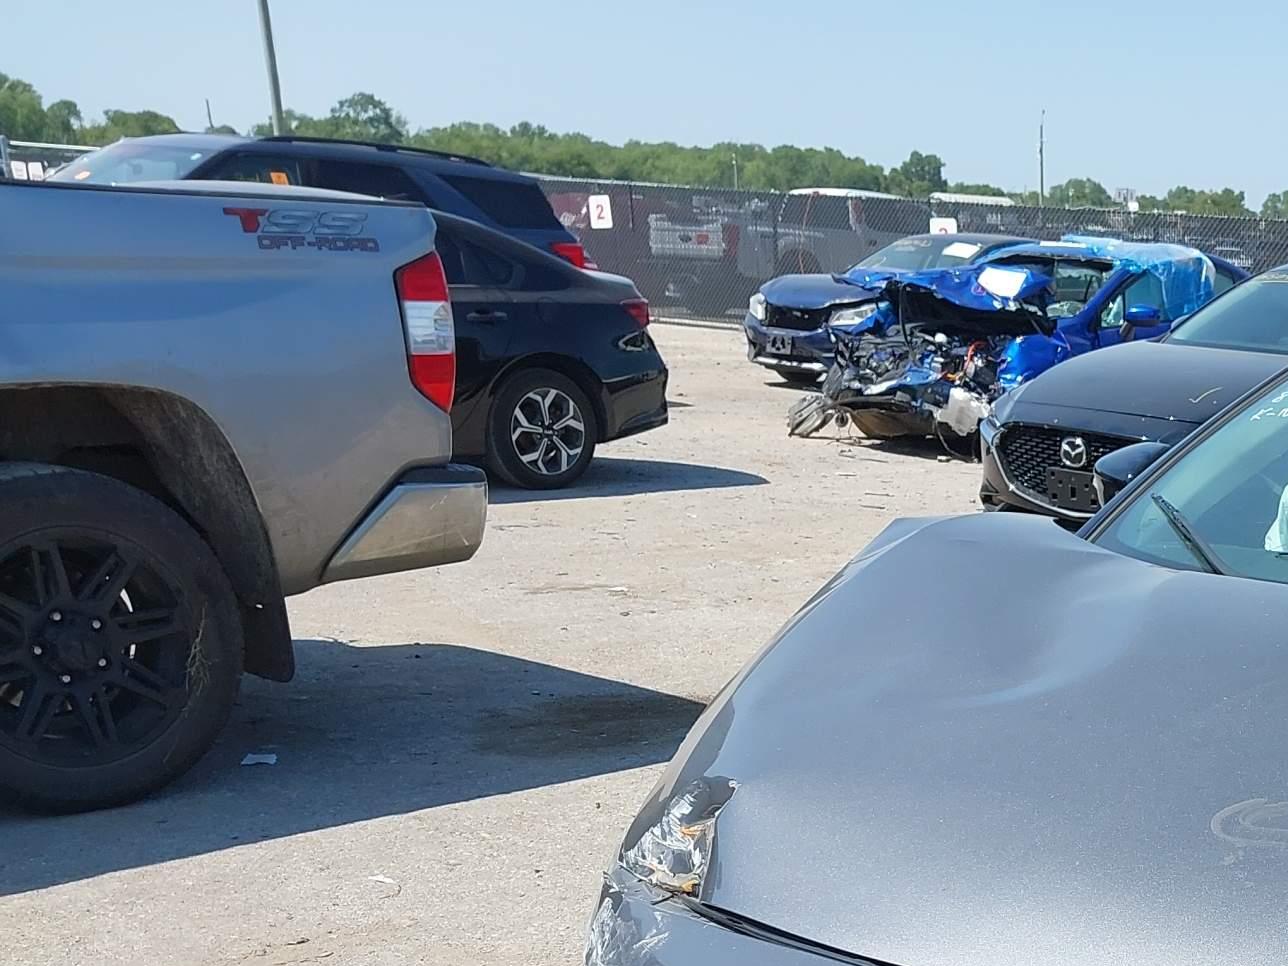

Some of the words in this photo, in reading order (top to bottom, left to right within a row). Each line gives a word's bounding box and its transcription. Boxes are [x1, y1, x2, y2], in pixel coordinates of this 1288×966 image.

[595, 203, 606, 221] 2
[222, 207, 369, 236] TSS
[257, 234, 380, 252] OFF-ROAD
